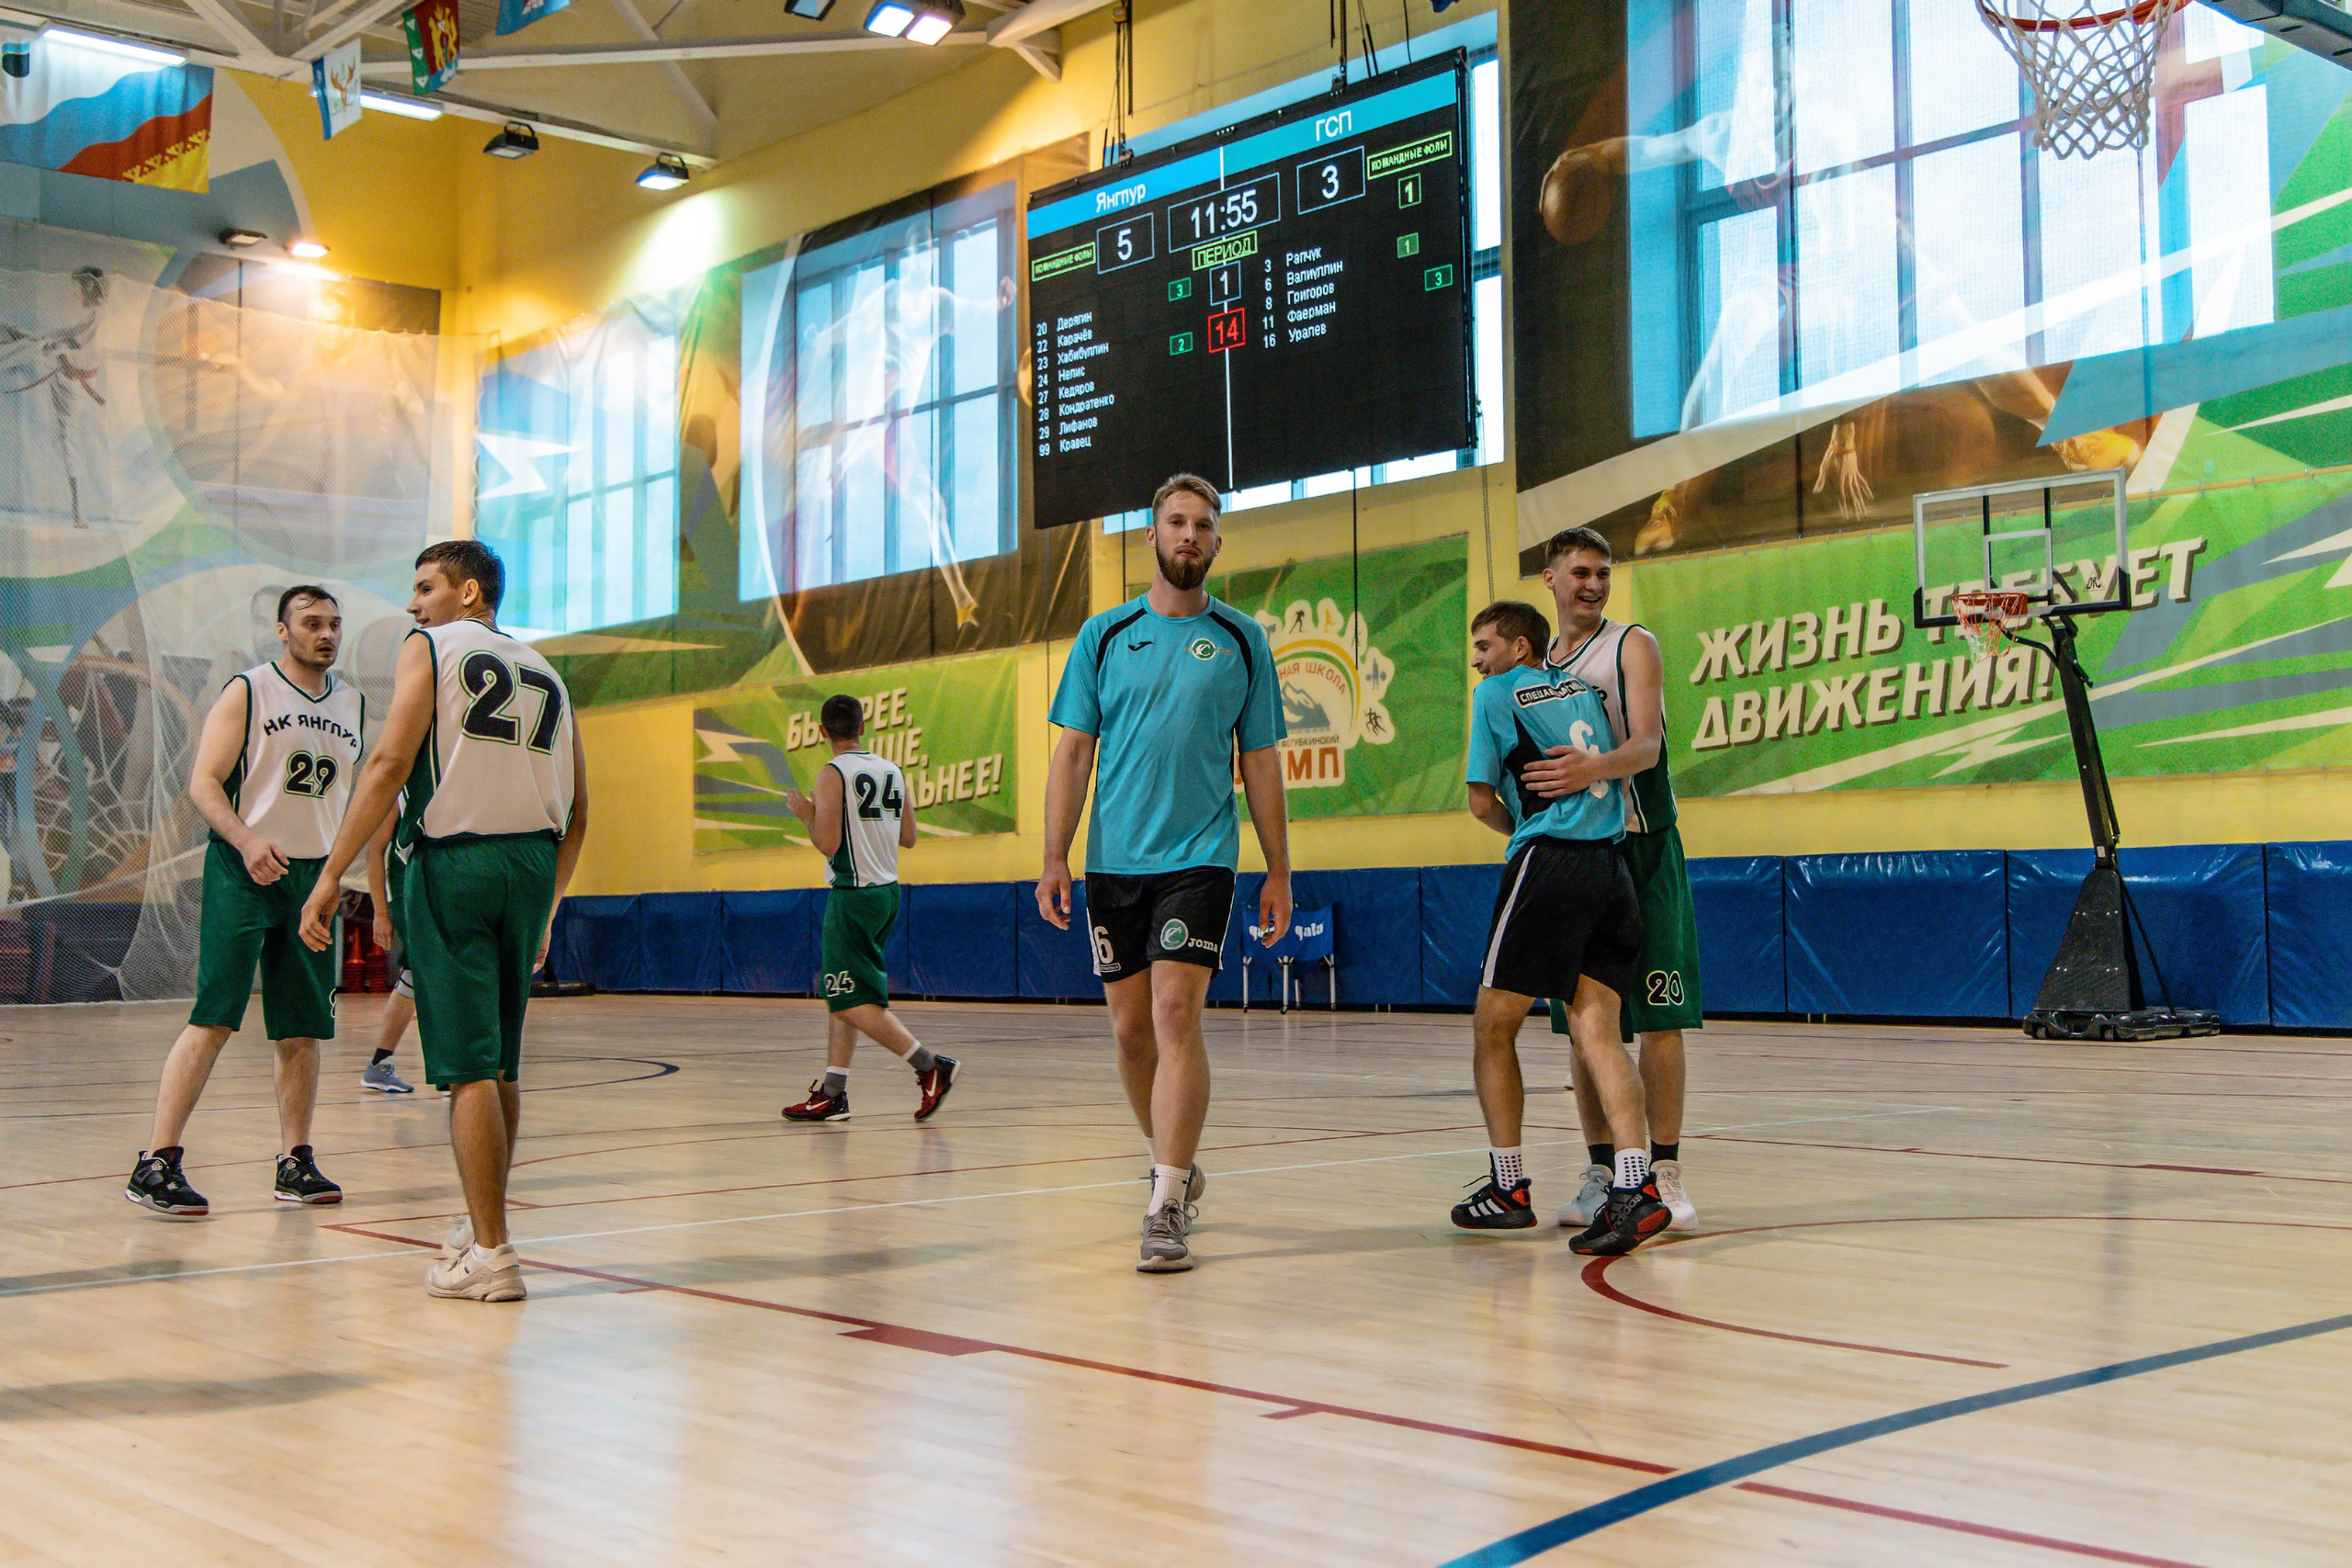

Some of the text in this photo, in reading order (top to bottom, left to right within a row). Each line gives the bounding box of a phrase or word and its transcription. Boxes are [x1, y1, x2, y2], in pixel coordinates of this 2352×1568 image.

[1316, 110, 1351, 141] ГСП
[1371, 146, 1423, 172] КОМАНДНЫЕ
[1321, 164, 1340, 199] 3
[1405, 181, 1413, 203] 1
[1095, 183, 1147, 213] Янгпур
[1191, 188, 1258, 239] 11:55
[1117, 228, 1133, 261] 5
[1196, 237, 1251, 266] ПЕРИОД
[1264, 247, 1322, 273] 3 Рапчук
[1219, 271, 1228, 296] 1
[1264, 261, 1343, 291] 6 Валиуллин
[1435, 272, 1442, 287] 3
[1176, 284, 1183, 298] 3
[1265, 283, 1335, 310] 8 Григоров
[1036, 311, 1092, 336] 20 Дерягин
[1262, 301, 1336, 330] 11 Фаерман
[1036, 329, 1093, 354] 22 Карачёв
[1215, 316, 1239, 345] 14
[1262, 333, 1276, 349] 16
[1178, 338, 1185, 352] 2
[1037, 356, 1048, 370] 23
[1037, 374, 1048, 388] 24
[1038, 380, 1095, 404] 27 Кедяров
[1038, 394, 1114, 422] 28 Кондратенко
[1039, 417, 1098, 440] 29 Лифанов
[1039, 435, 1091, 457] 99 Кравец
[1690, 598, 1902, 685] ЖИЗНЬ
[1306, 661, 1346, 695] ШКОЛА
[458, 649, 563, 756] 27
[1690, 642, 2056, 751] ДВИЖЕНИЯ!
[263, 714, 357, 748] НК ЯНГПУР
[786, 687, 913, 752] БЫРЕЕ,
[284, 750, 338, 798] 29
[853, 771, 905, 821] 24
[1093, 926, 1114, 964] 6
[1295, 921, 1324, 942] gala
[824, 970, 855, 997] 24
[1645, 970, 1684, 1006] 20
